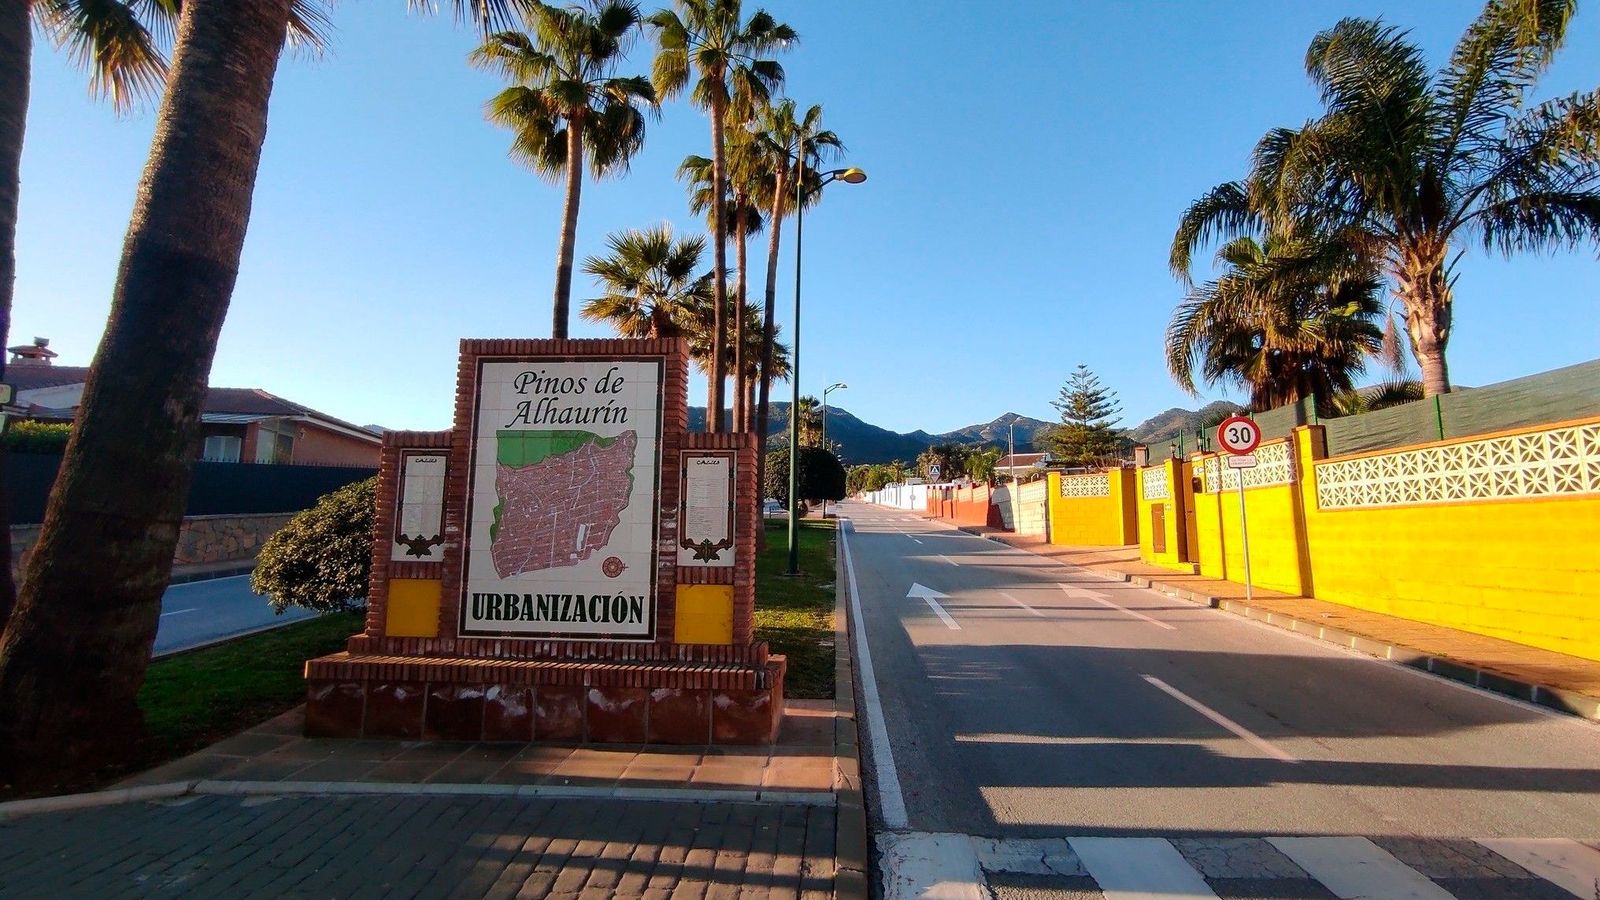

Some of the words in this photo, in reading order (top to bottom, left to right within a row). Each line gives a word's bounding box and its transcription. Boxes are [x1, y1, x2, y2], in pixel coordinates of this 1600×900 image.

[513, 370, 587, 396] Pinos
[594, 366, 624, 393] de
[505, 397, 628, 428] Alhaurín
[1228, 427, 1251, 444] 30
[472, 591, 644, 624] URBANIZACIÓN
